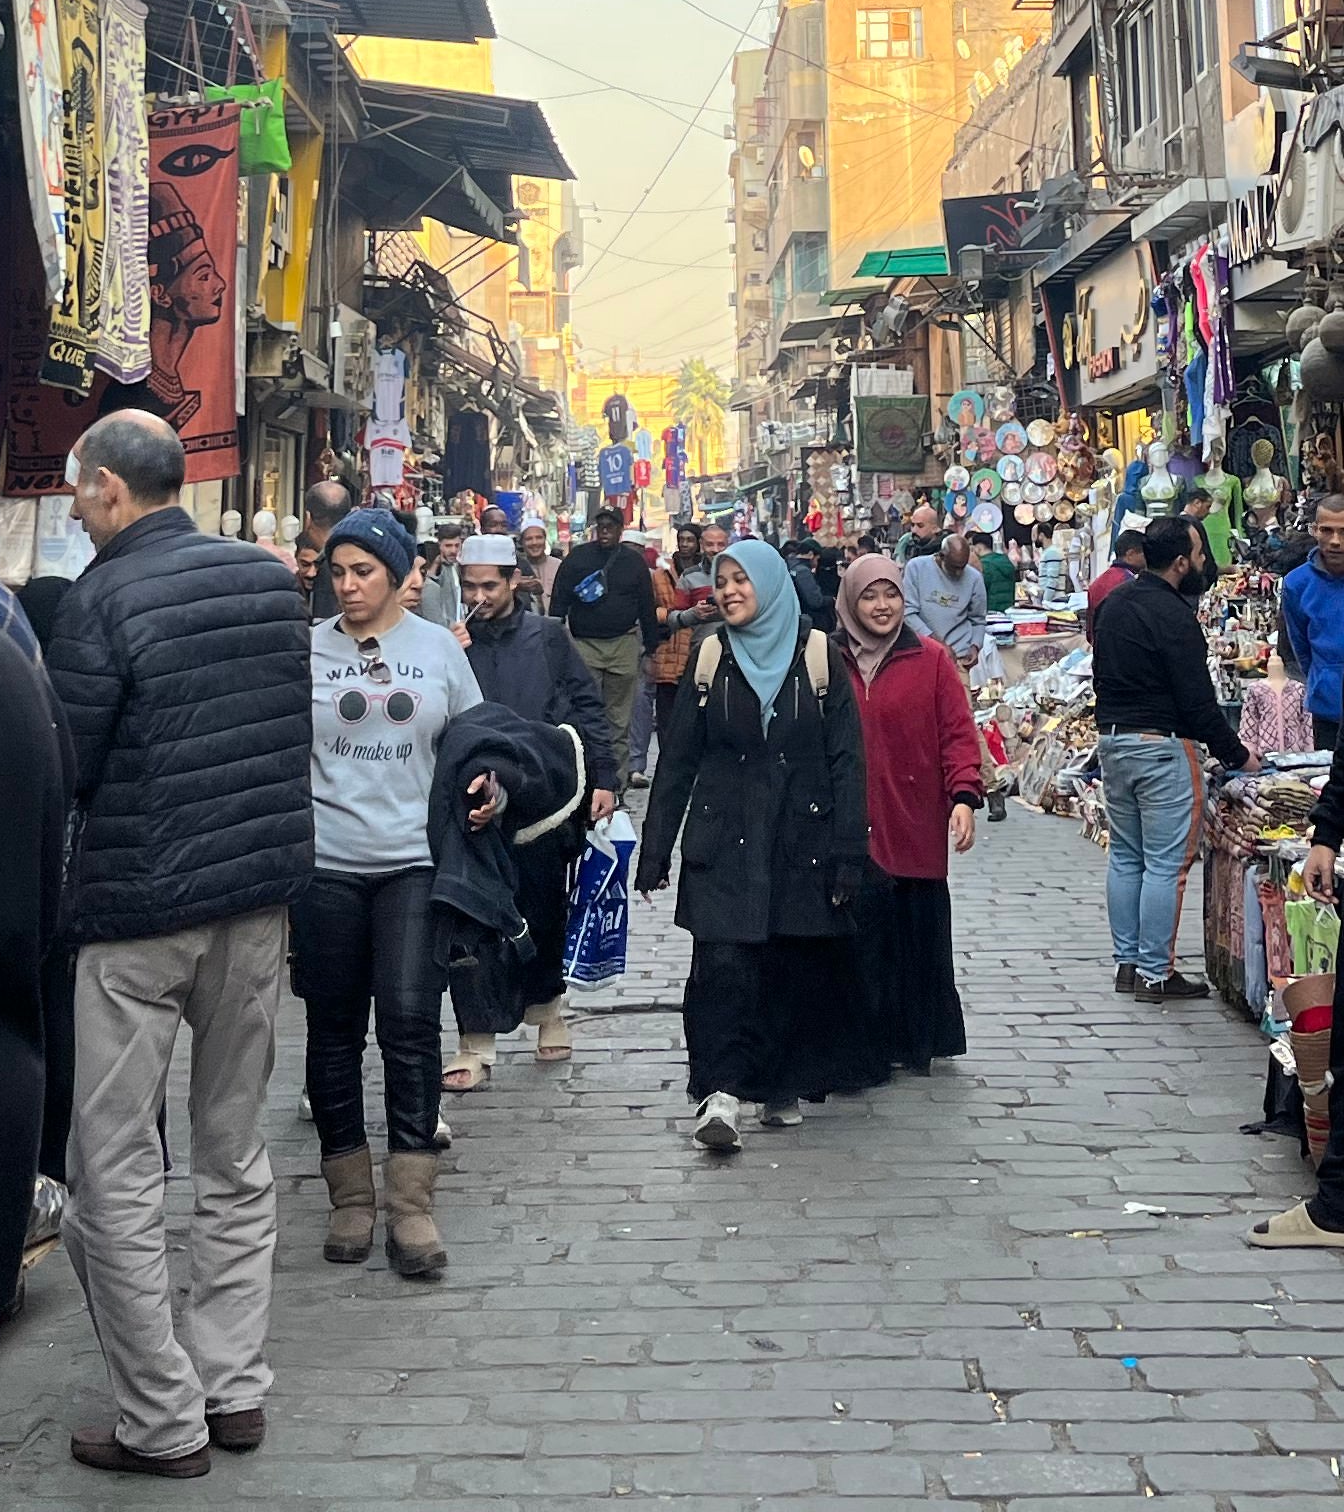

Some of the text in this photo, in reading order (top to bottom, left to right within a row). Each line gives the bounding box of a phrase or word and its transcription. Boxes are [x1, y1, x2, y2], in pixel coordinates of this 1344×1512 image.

[606, 453, 623, 473] 10
[325, 660, 425, 681] WAK UP
[325, 735, 414, 765] No make up
